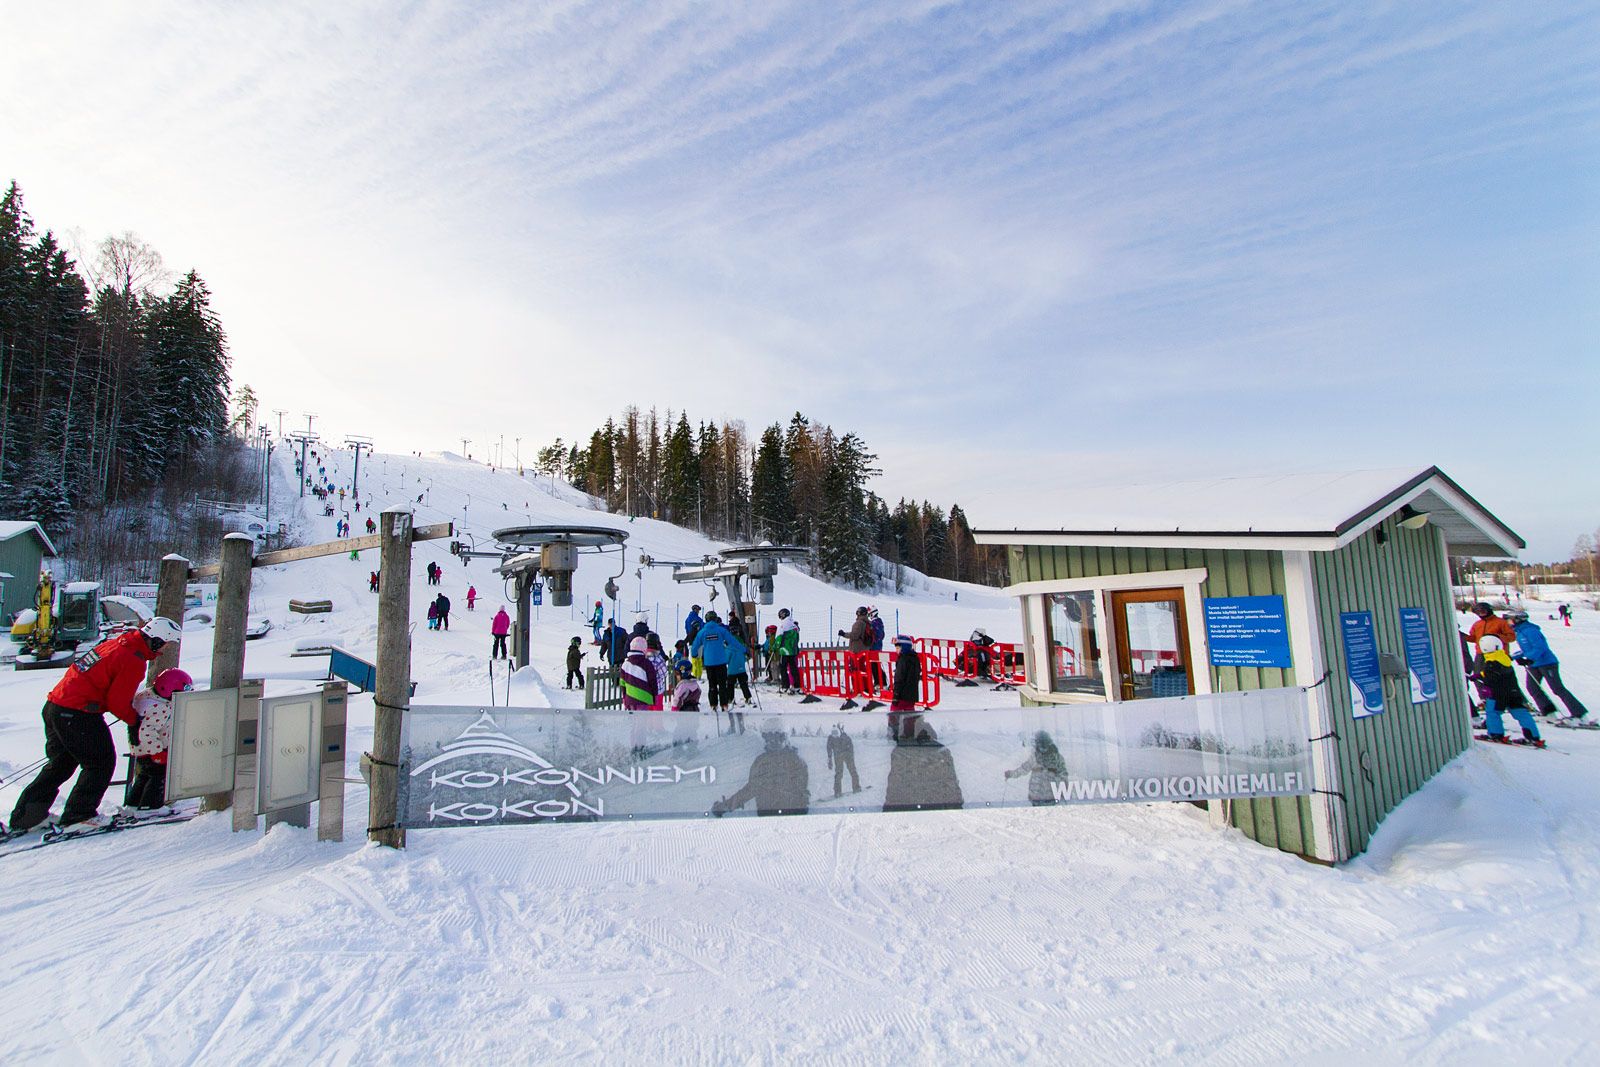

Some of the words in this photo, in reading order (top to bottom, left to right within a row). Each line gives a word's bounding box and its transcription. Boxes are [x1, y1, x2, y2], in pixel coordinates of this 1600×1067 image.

[428, 764, 717, 791] KOKONNIEMI
[1050, 771, 1305, 801] WWW.KOKONNIEMI.FI
[426, 797, 604, 822] KOKON
